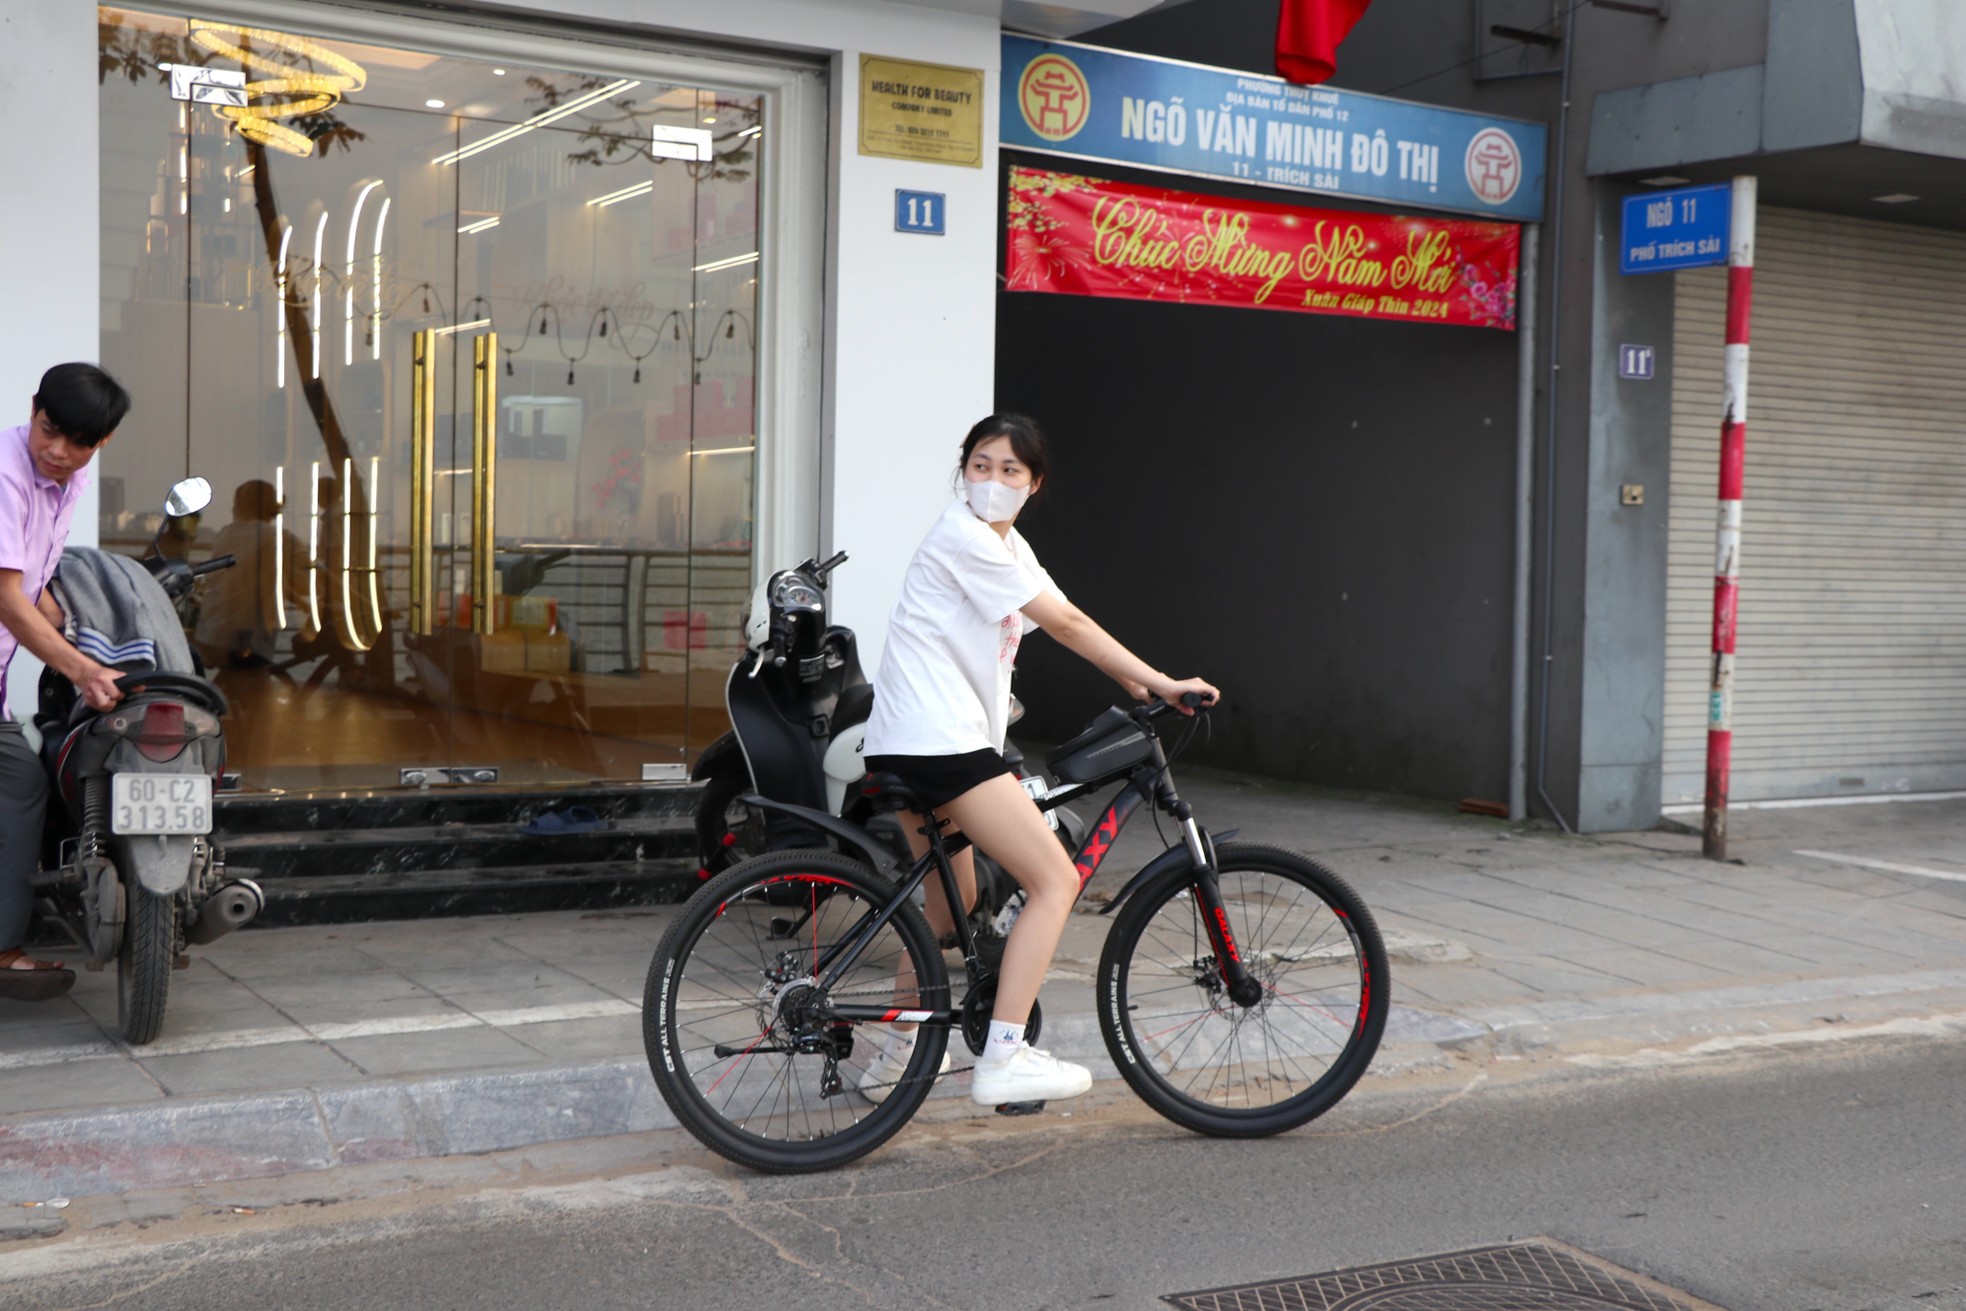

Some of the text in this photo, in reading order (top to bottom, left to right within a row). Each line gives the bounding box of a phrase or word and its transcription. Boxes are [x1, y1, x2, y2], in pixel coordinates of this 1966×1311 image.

[872, 80, 972, 104] HEALTH FOR BEAUTY
[927, 106, 953, 117] LIMITED
[1336, 110, 1349, 122] 12
[1121, 96, 1439, 193] NGÕ VĂN MINH ĐÔ THỊ
[1232, 161, 1249, 178] 11
[1267, 164, 1310, 187] TRÍCH
[1314, 171, 1339, 190] SÀI
[907, 198, 933, 227] 11
[1682, 198, 1697, 224] 11
[1092, 195, 1182, 270] Chúc
[1299, 220, 1388, 288] Năm
[1630, 240, 1657, 262] PHỐ
[1658, 238, 1695, 260] TRÍCH
[1302, 288, 1339, 309] Xuân
[1411, 298, 1449, 319] 2024
[129, 778, 196, 803] 60-C2
[120, 805, 205, 830] 313.58
[1214, 907, 1240, 963] GALAXY
[660, 976, 671, 1026] TERRAINS
[1110, 980, 1121, 1025] TERRAINS
[660, 1026, 669, 1046] ALL
[1115, 1024, 1126, 1043] ALL
